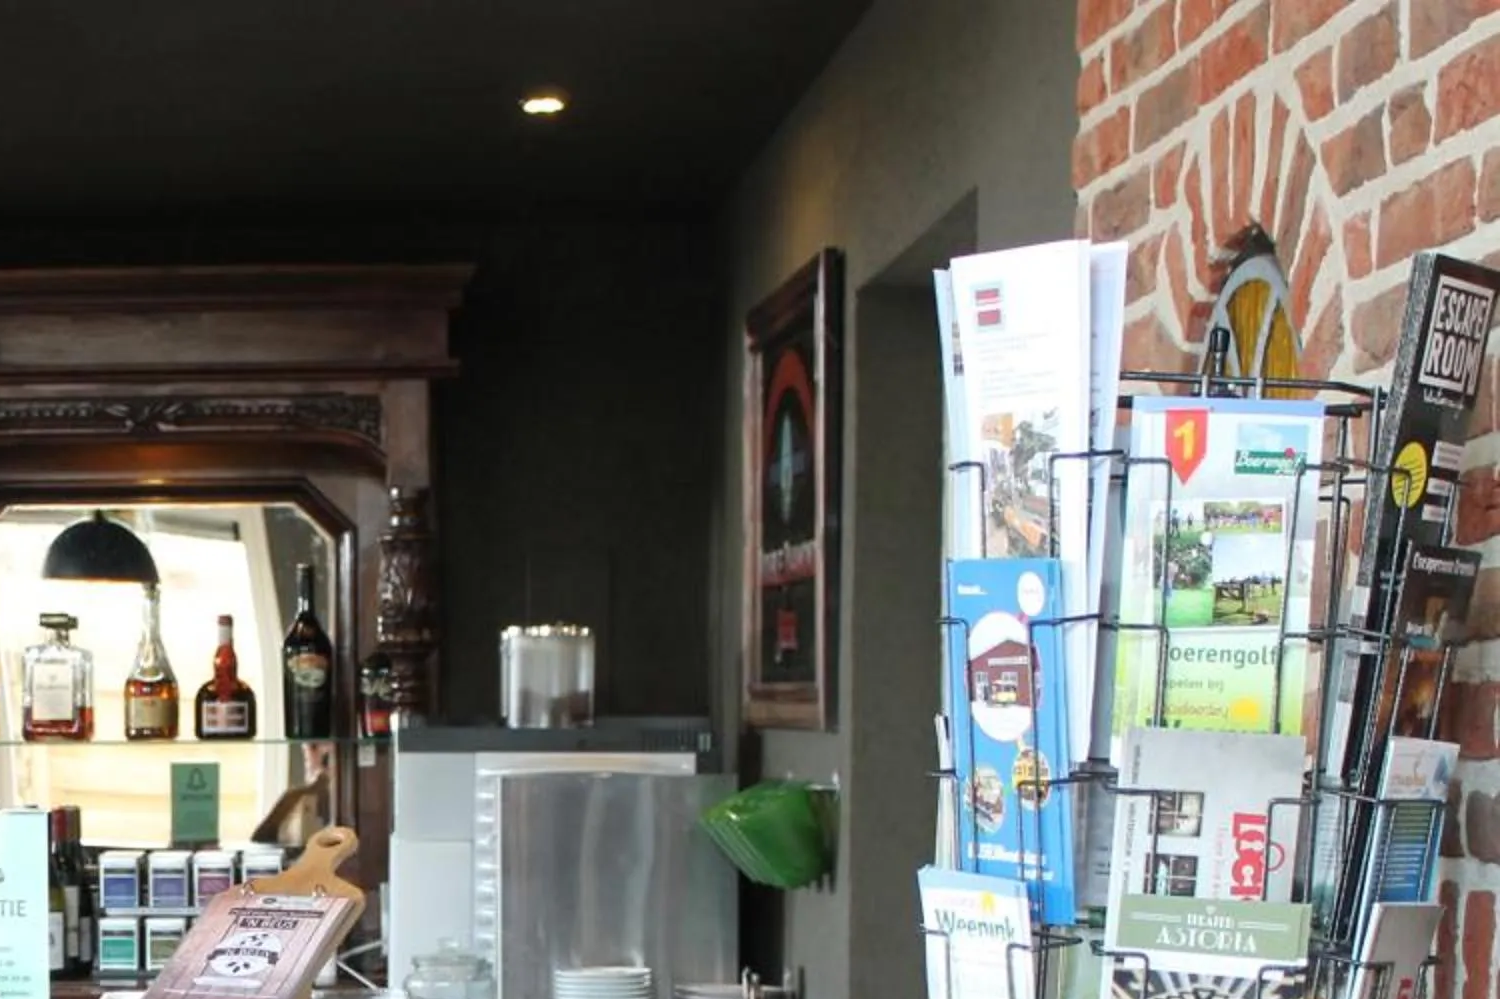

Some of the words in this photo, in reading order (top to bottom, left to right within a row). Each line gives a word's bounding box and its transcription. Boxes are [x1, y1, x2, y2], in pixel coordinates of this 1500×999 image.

[1435, 287, 1487, 340] ESCAPE
[1425, 331, 1482, 396] ROOM
[1174, 419, 1196, 461] 1
[1161, 643, 1284, 669] oerengolf
[1155, 926, 1258, 953] ASTORIA
